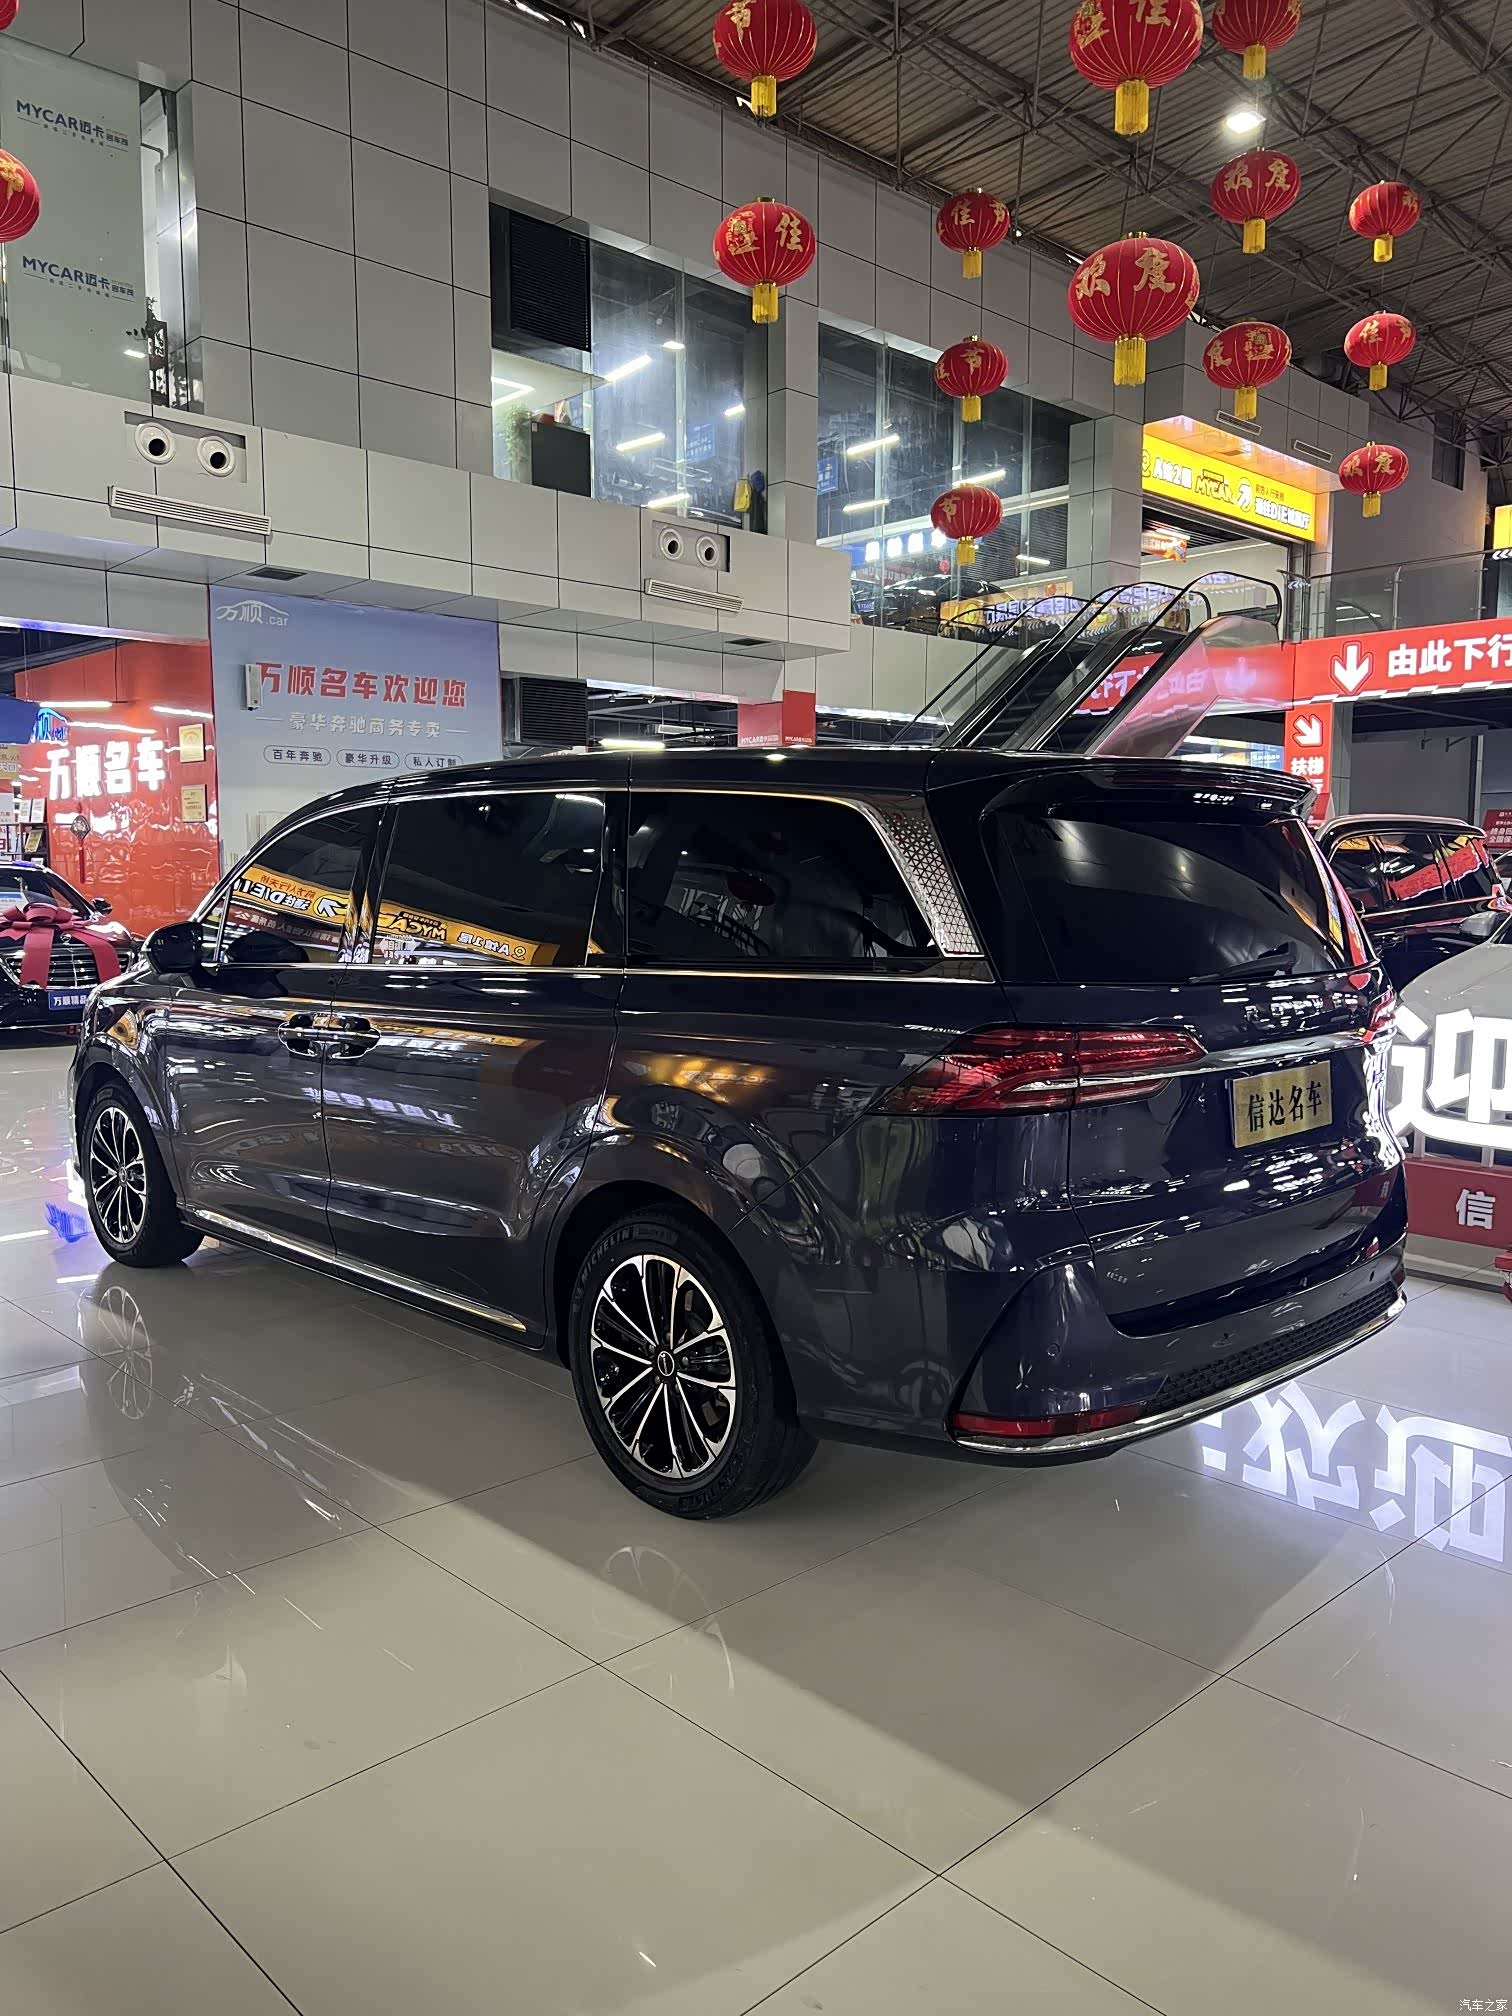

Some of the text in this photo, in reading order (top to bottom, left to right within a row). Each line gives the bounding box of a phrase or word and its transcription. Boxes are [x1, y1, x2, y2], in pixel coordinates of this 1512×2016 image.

[1387, 633, 1512, 677] 由此下行
[255, 662, 468, 708] 万顺名车欢迎您
[289, 711, 441, 739] 豪华奔驰商务专卖
[46, 737, 167, 800] 万顺名车
[272, 749, 324, 763] 百年奔驰
[344, 752, 393, 766] 豪华升级
[412, 756, 457, 768] 私人订制
[1291, 756, 1324, 777] 扶梯
[1387, 1003, 1512, 1151] 迎
[1247, 1080, 1323, 1133] 信达名车
[1455, 1187, 1497, 1231] 信
